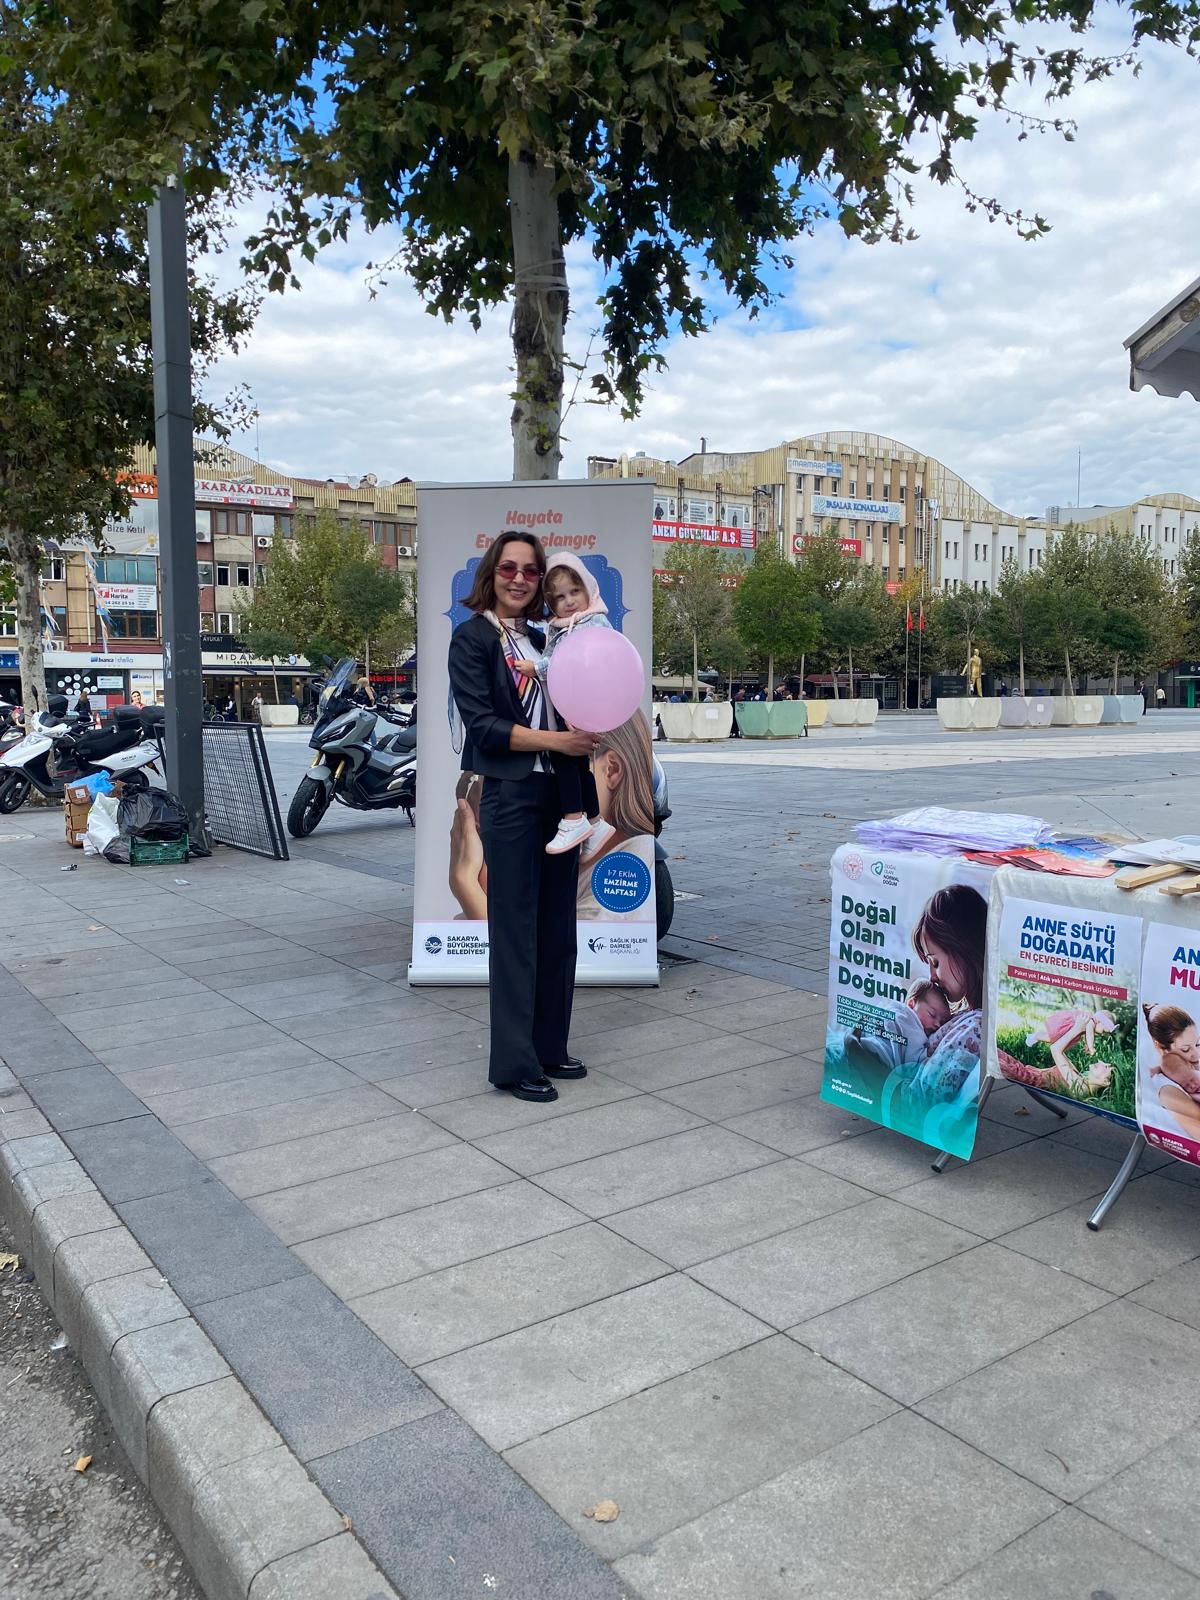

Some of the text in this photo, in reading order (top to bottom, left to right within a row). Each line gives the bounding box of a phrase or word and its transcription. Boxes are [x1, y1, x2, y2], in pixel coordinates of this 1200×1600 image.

[200, 482, 290, 496] KARAKADILAR
[506, 510, 563, 528] Hayata
[475, 534, 496, 549] En
[722, 531, 739, 545] A.Ş.
[603, 877, 638, 888] EMZİRME
[607, 869, 637, 878] 1-7 EKİM
[603, 887, 637, 897] HAFTASI
[841, 895, 897, 925] Doğal
[840, 919, 885, 947] Olan
[1022, 915, 1116, 945] ANNE SÜTÜ
[1020, 932, 1115, 966] DOĞADAKİ
[839, 942, 911, 980] Normal
[1019, 950, 1114, 977] EN ÇEVRECİ BESİNDİR
[838, 966, 908, 1003] Doğum
